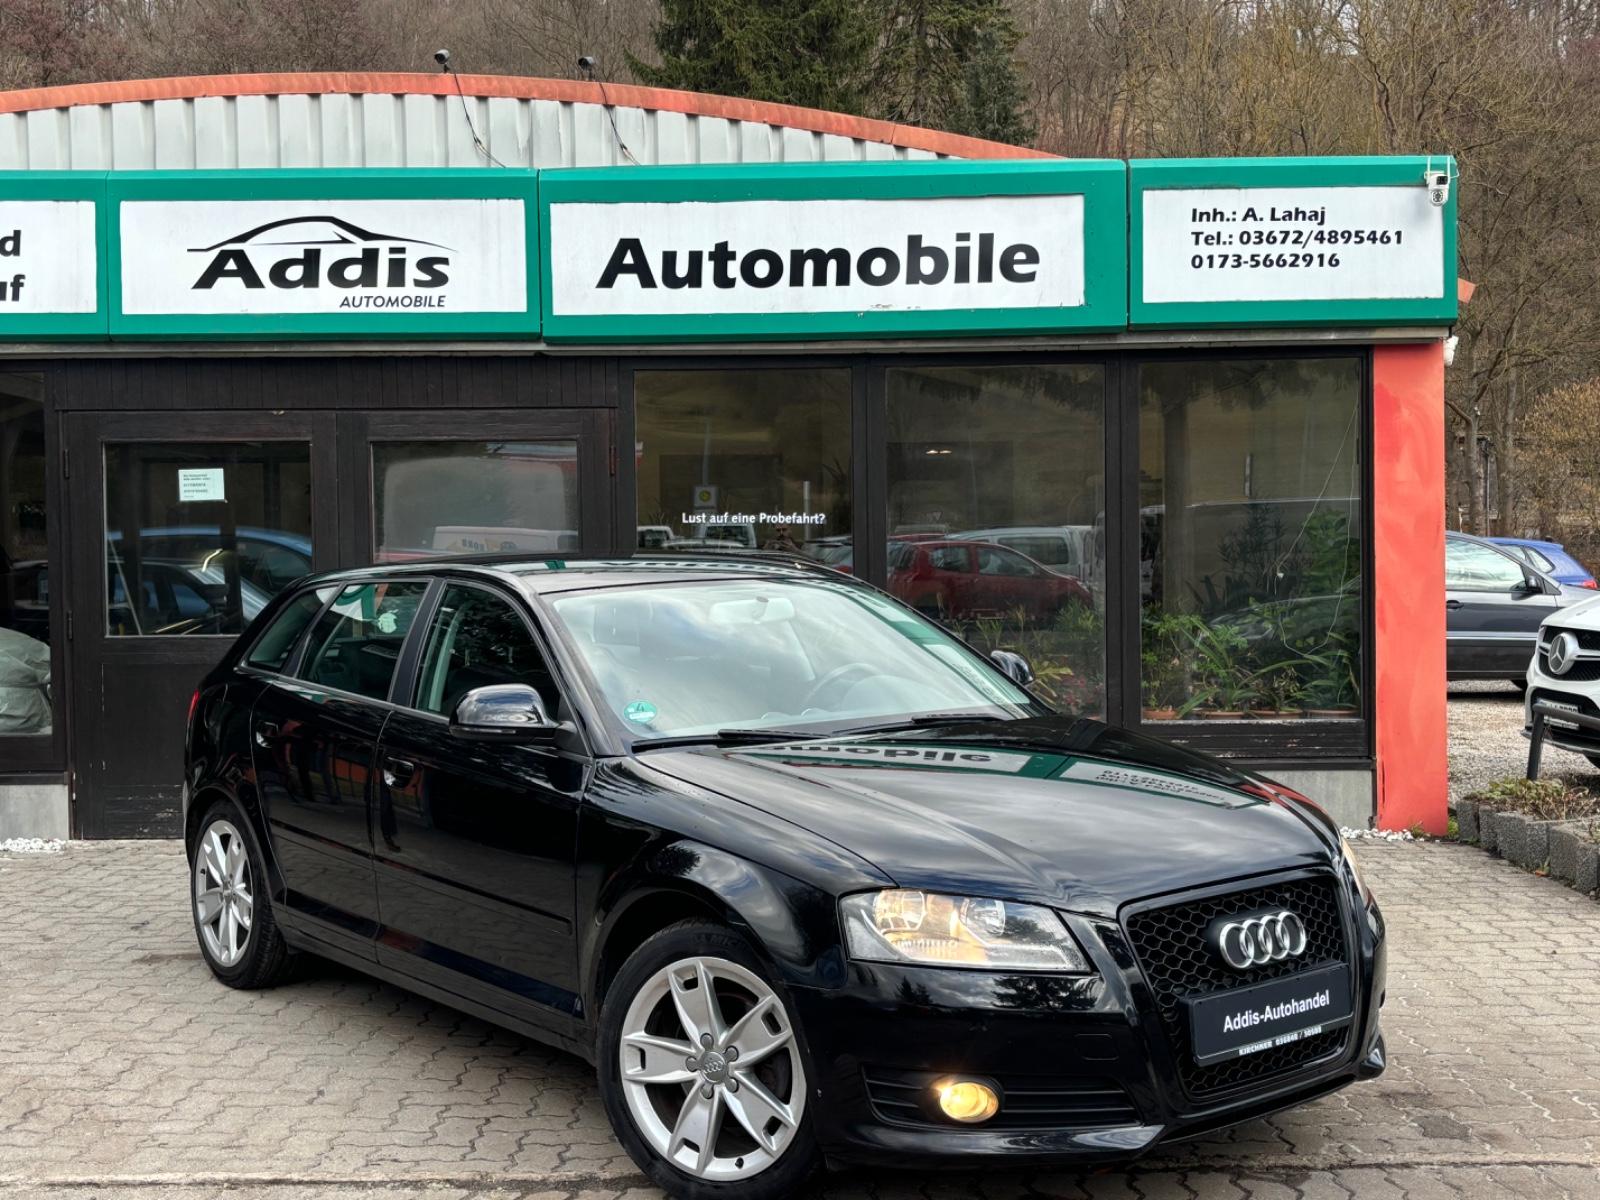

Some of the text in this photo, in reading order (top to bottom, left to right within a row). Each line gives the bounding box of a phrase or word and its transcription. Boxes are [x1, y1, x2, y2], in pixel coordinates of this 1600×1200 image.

[1191, 206, 1326, 226] Inh.: A. Lahaj
[1190, 229, 1403, 249] Tel.: 03672/4895461
[190, 246, 450, 290] Addis
[595, 232, 1040, 290] Automobile
[1190, 252, 1340, 269] 0173-5662916
[339, 295, 446, 308] AUTOMOBILE
[682, 511, 826, 525] Lust auf eine Probefahrt?
[1223, 989, 1330, 1033] Addis-Autohandel
